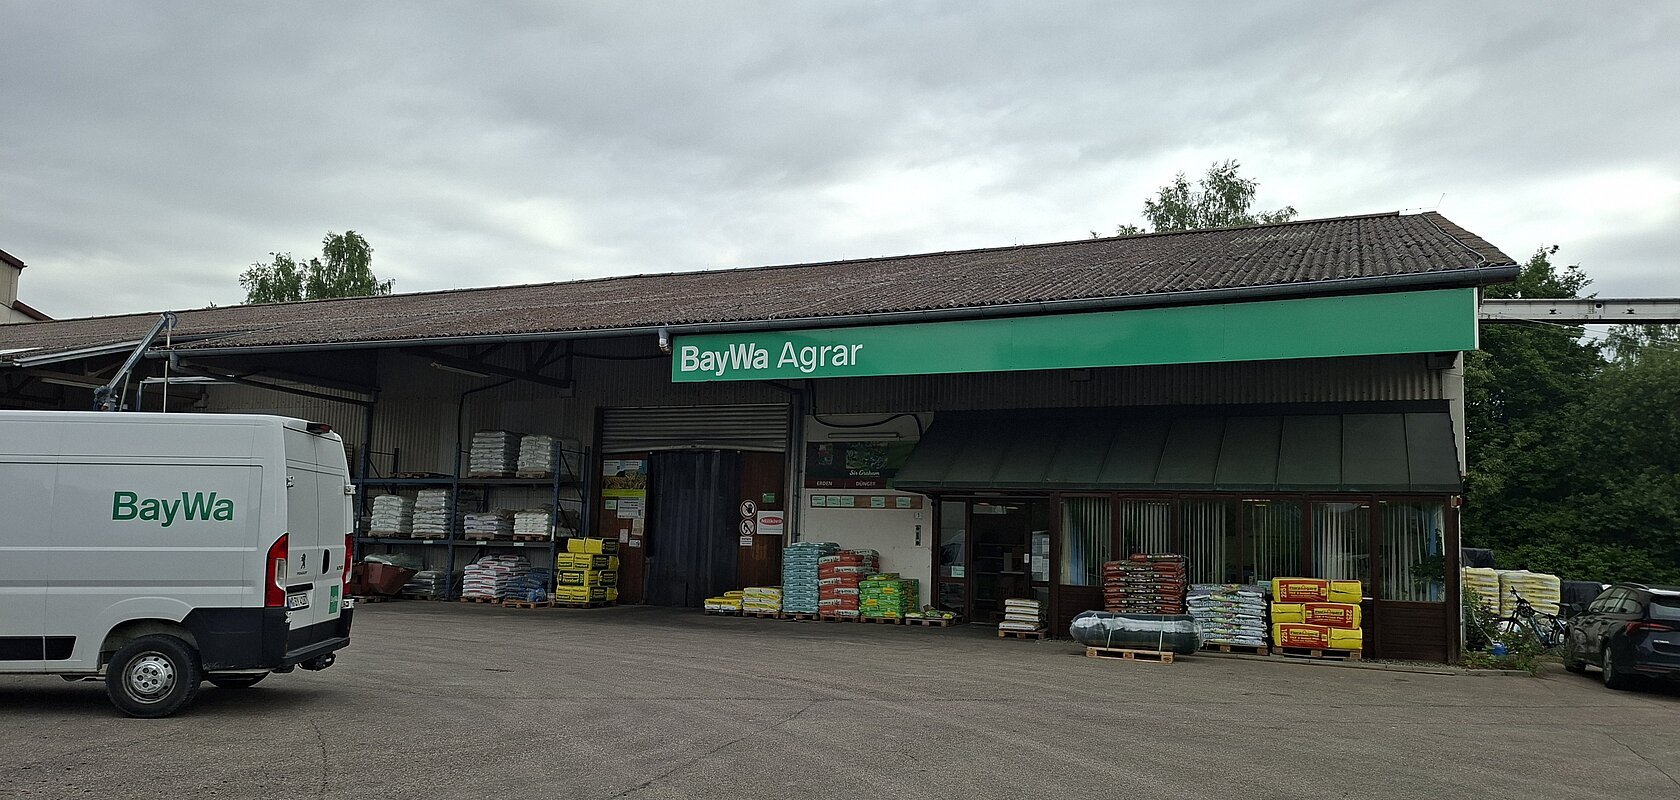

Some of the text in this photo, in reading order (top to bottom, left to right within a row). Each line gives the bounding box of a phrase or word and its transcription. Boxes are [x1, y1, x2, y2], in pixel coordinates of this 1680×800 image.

[681, 342, 863, 376] BayWa Agrar
[112, 491, 235, 527] BayWa
